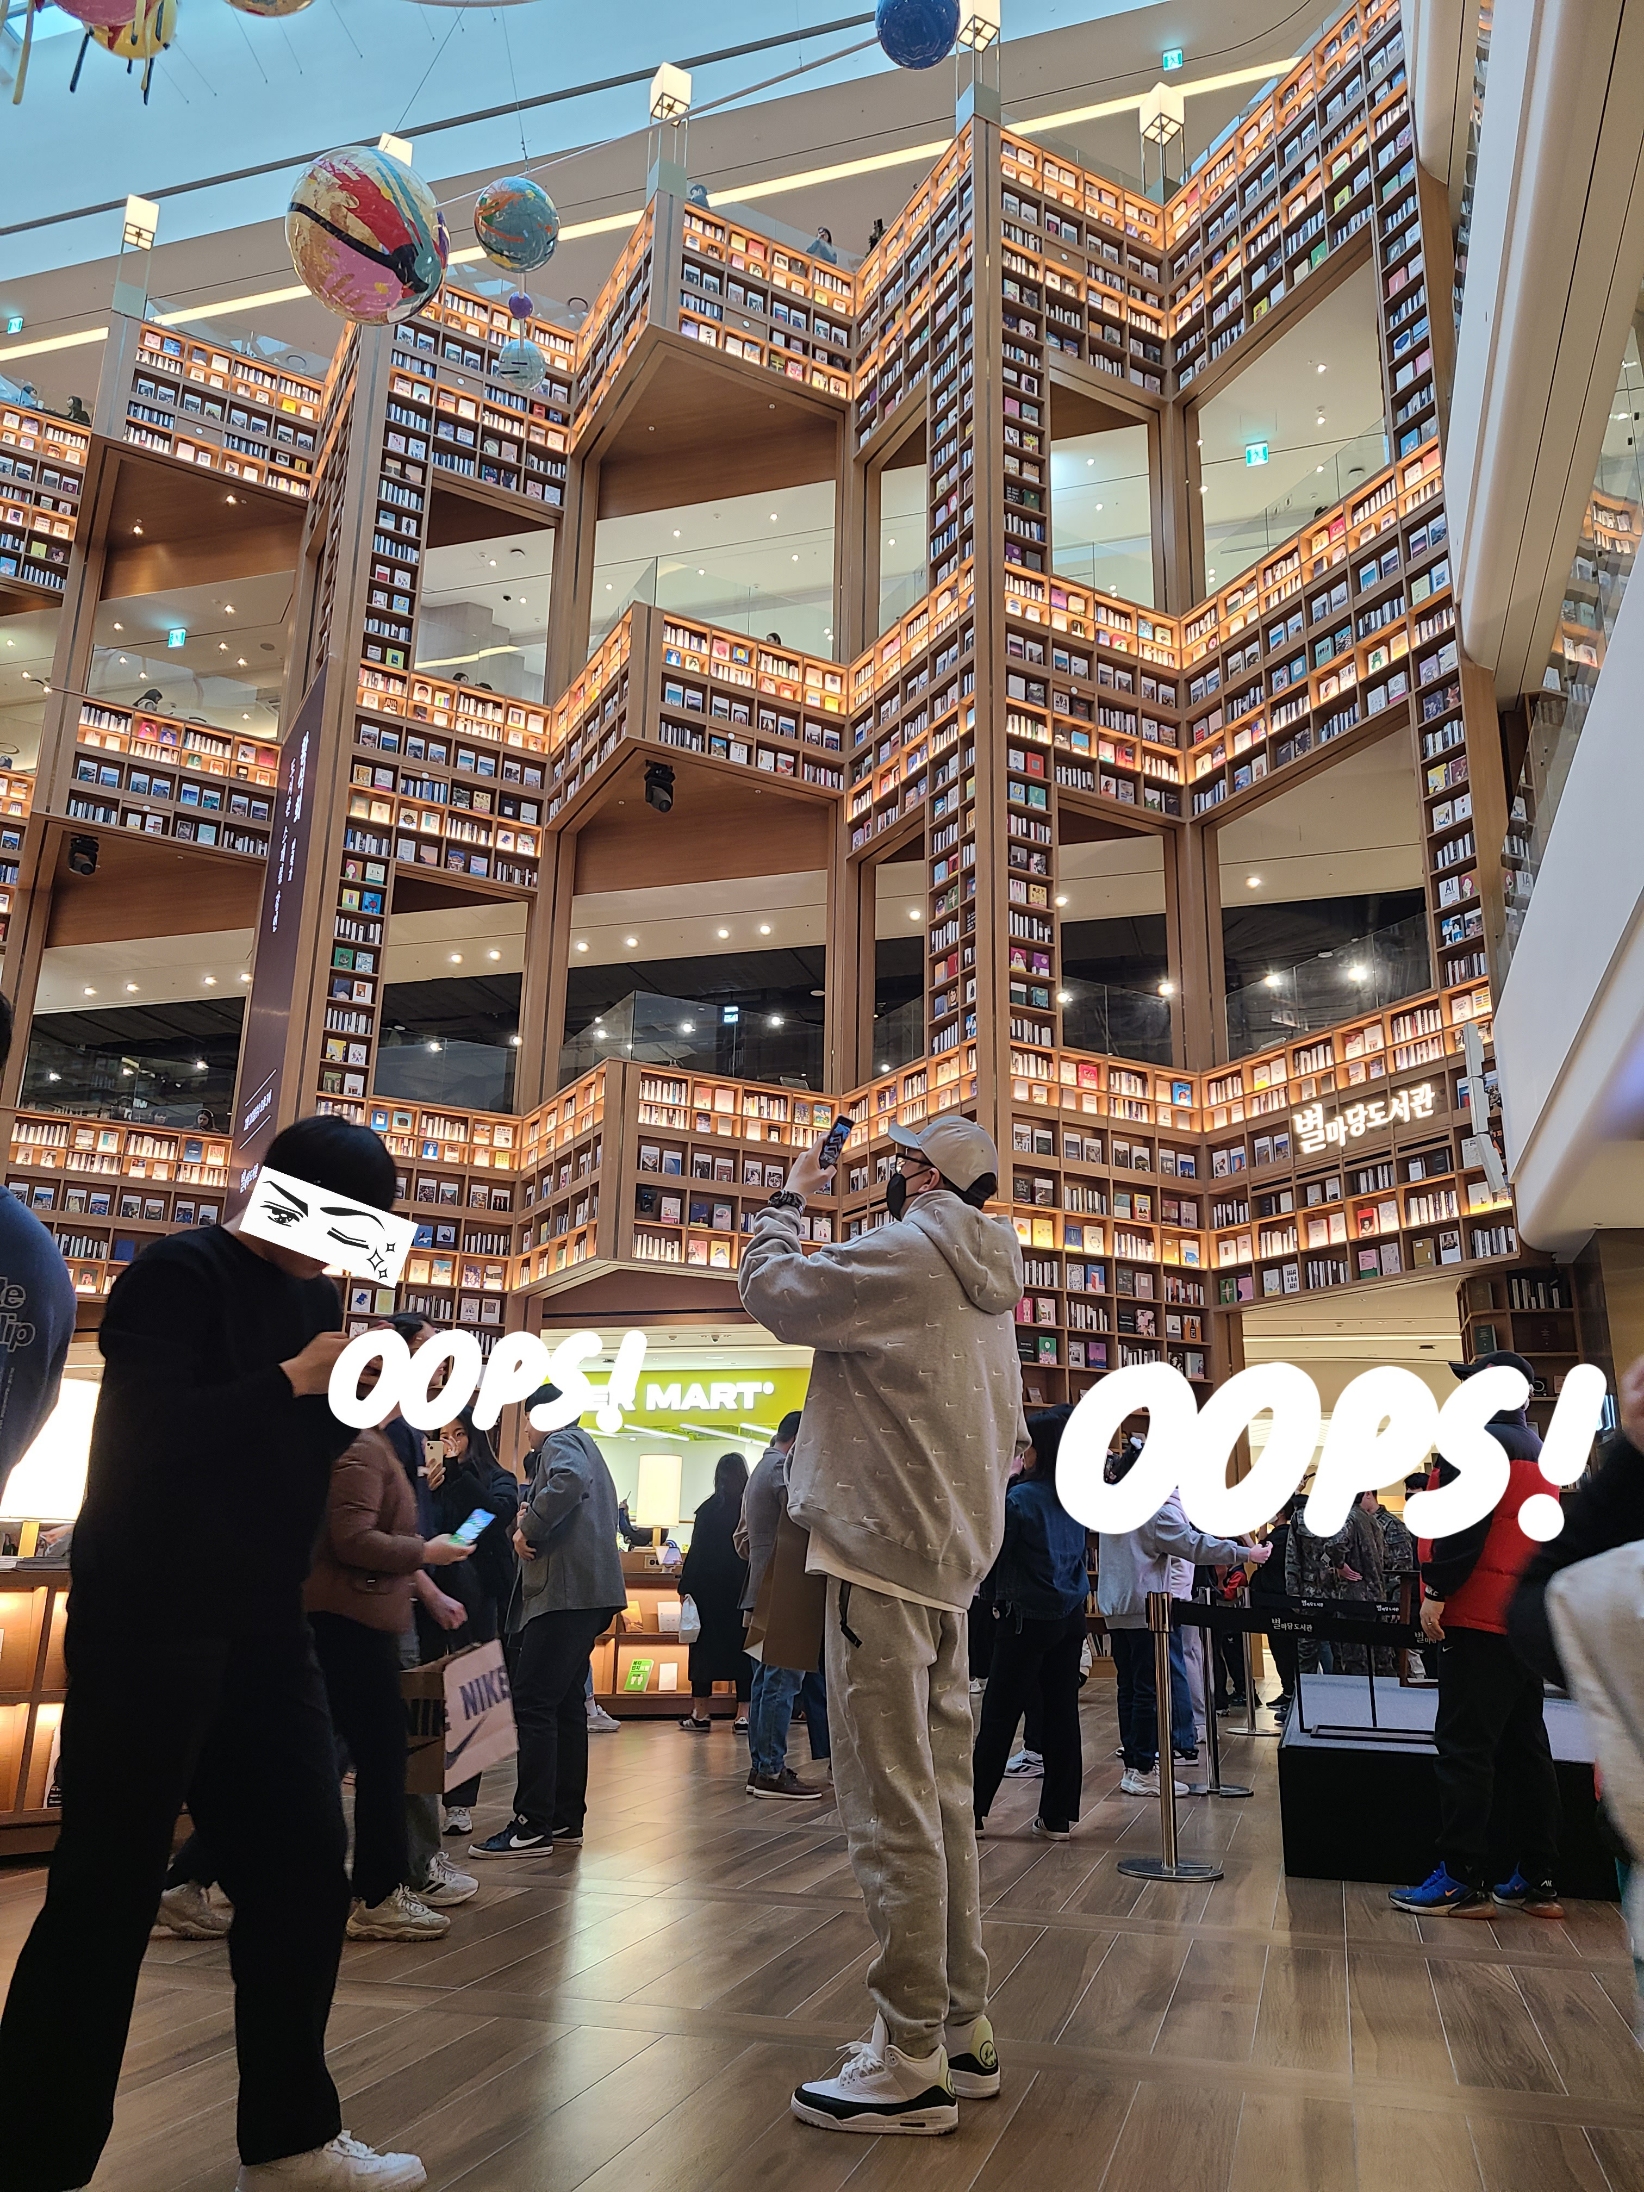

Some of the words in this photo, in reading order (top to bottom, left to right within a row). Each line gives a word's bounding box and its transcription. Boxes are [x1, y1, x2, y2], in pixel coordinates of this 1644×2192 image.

[1292, 1083, 1436, 1154] 별마당도서관
[1271, 1617, 1313, 1632] 별마당도서관
[458, 1665, 512, 1721] NIKE
